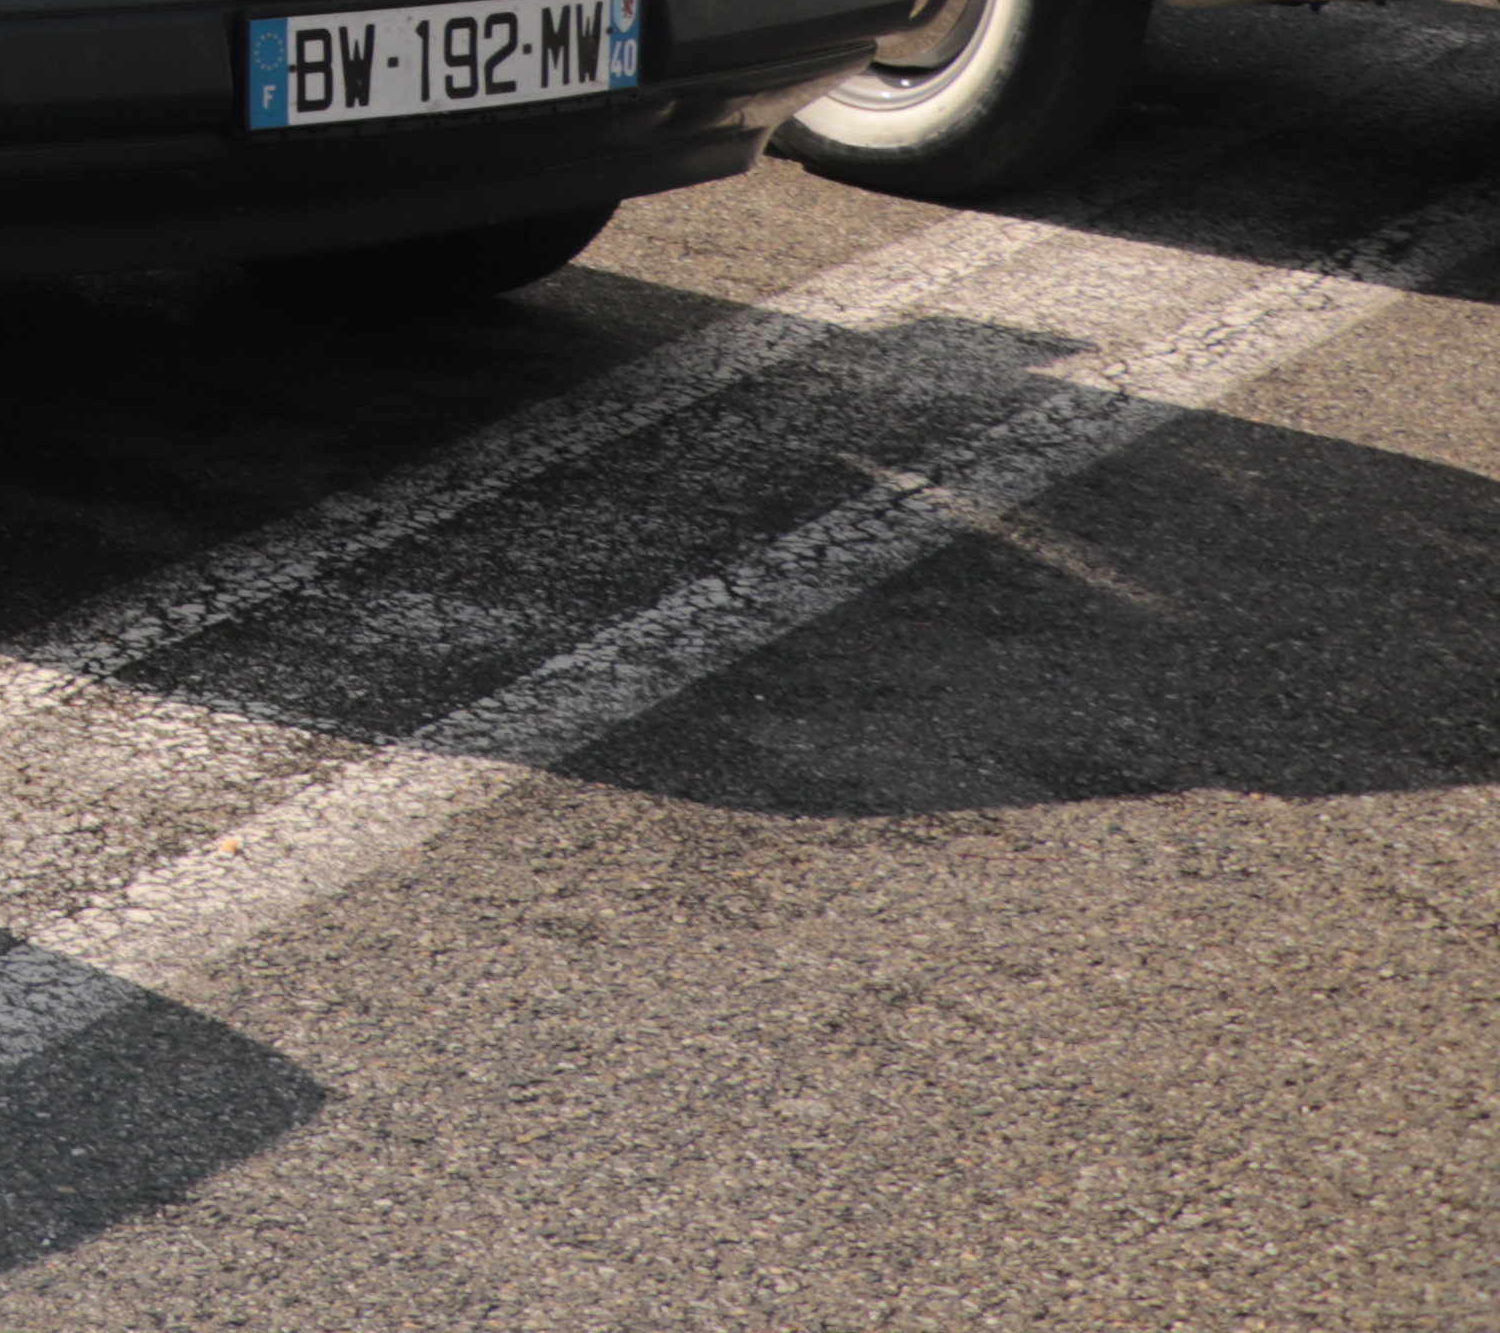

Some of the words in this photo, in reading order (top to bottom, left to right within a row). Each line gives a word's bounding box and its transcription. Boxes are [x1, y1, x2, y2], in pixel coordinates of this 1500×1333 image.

[295, 0, 604, 113] BW-192-MW
[610, 38, 638, 79] 40
[262, 84, 276, 109] F
